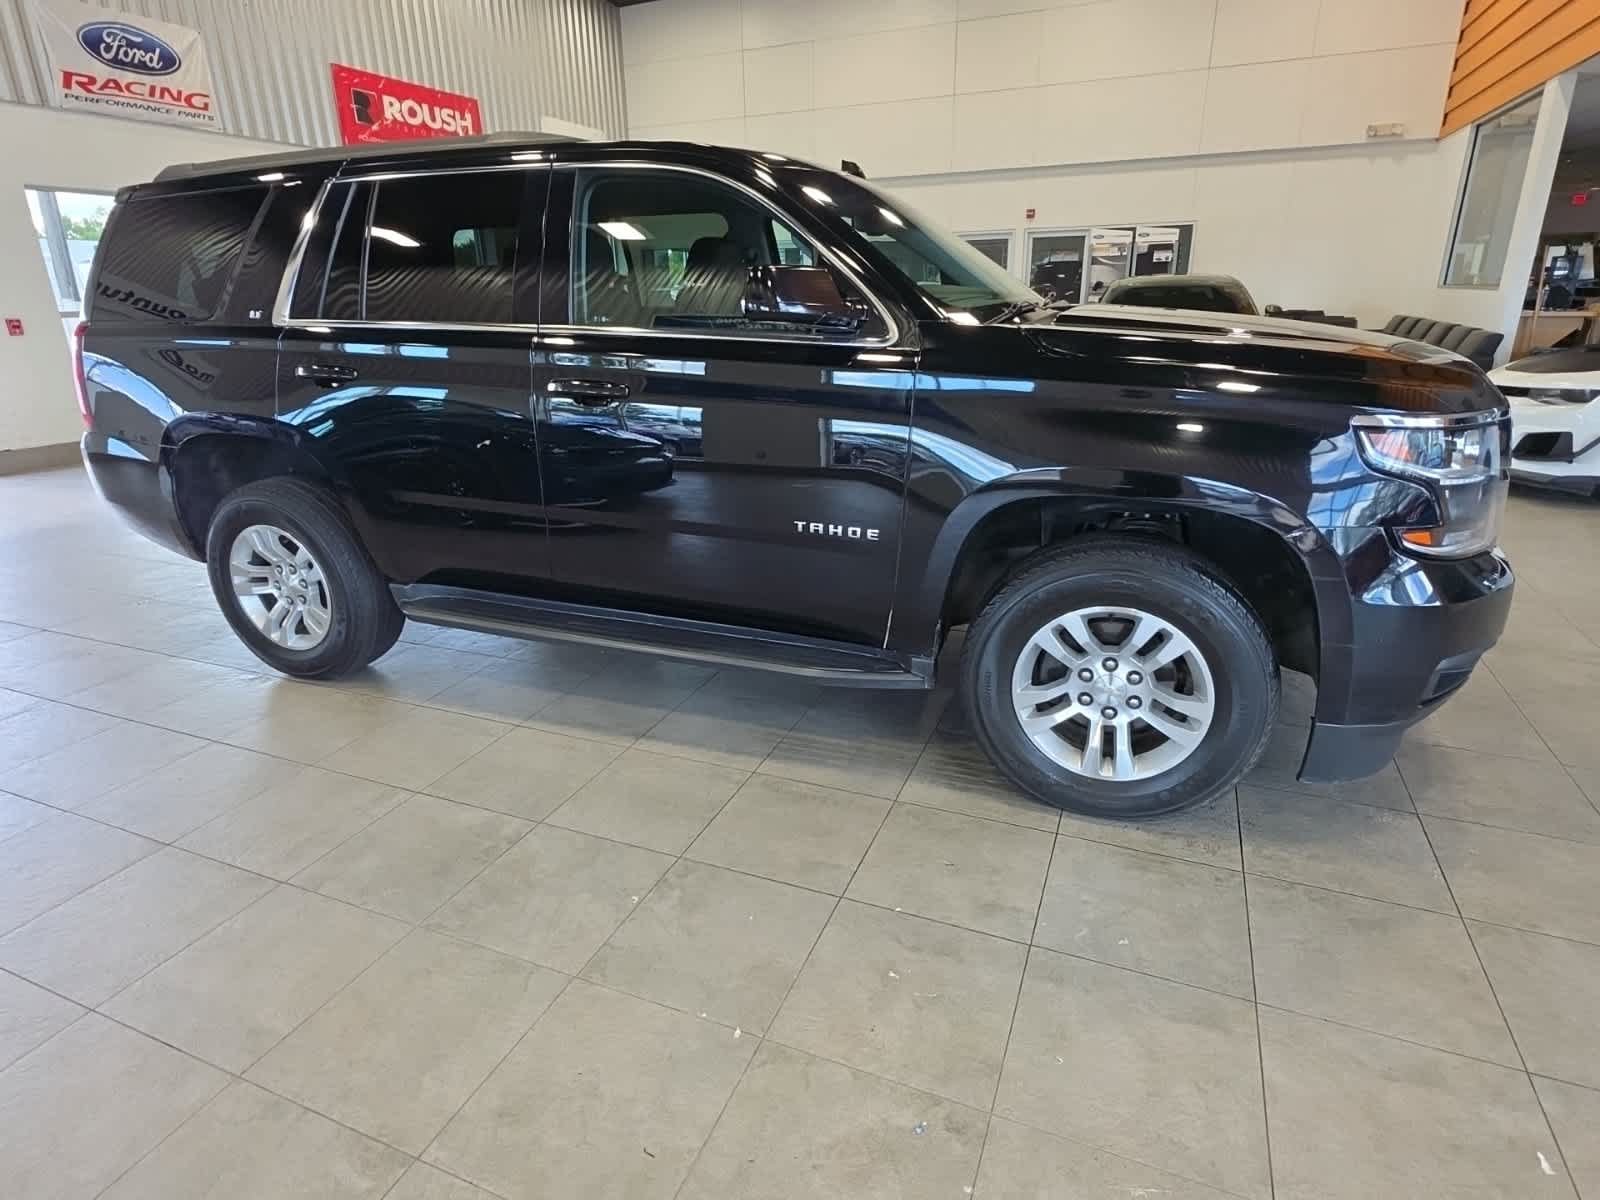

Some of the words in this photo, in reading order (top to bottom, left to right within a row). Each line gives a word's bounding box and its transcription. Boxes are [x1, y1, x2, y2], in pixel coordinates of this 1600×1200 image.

[99, 28, 163, 70] Ford
[60, 69, 210, 112] RACING
[64, 92, 176, 115] PERFORMANCE
[177, 110, 215, 122] PARTS
[381, 94, 474, 137] ROUSH
[793, 520, 880, 541] TAHOE
